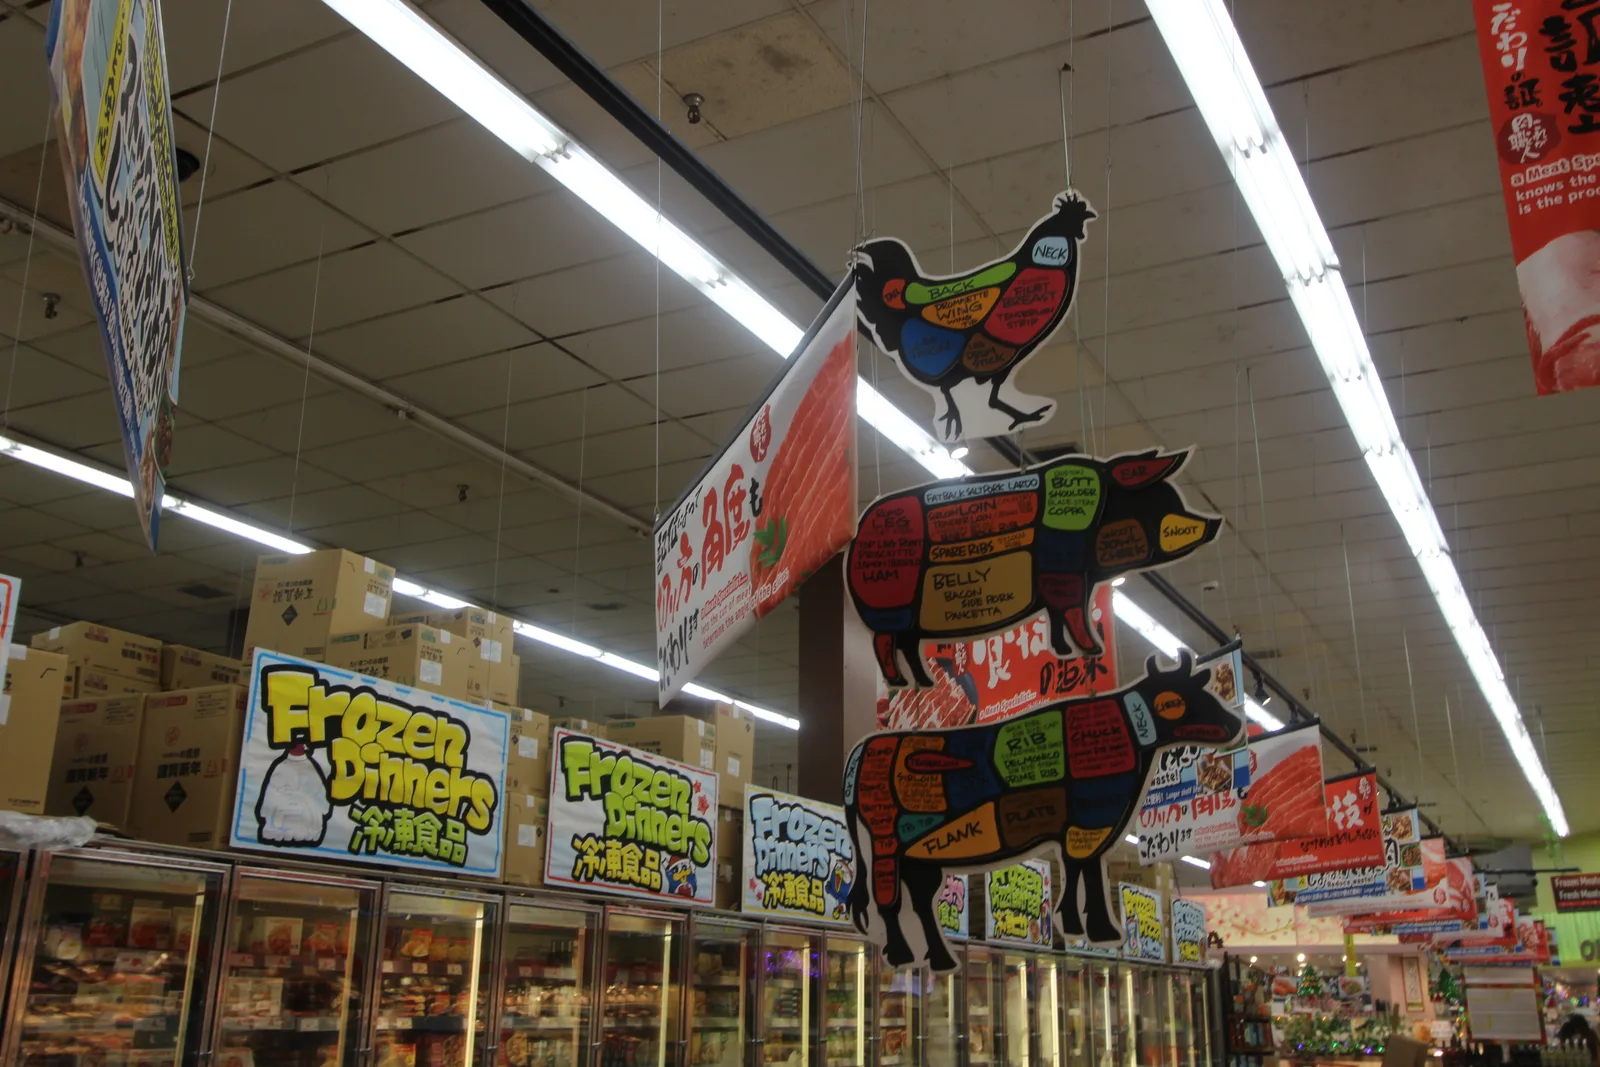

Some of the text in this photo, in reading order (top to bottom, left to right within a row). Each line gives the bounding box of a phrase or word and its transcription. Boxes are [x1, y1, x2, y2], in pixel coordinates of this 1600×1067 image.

[1510, 173, 1525, 189] a
[1526, 157, 1571, 184] Meat
[1516, 173, 1597, 202] knows the
[1518, 200, 1532, 216] is
[1536, 195, 1563, 211] the
[1034, 243, 1068, 261] NECK
[929, 280, 974, 300] BACK
[1003, 291, 1058, 308] BREAST
[936, 302, 983, 321] WING
[1050, 476, 1095, 489] BUTT
[1048, 487, 1097, 499] SHOULDER
[959, 499, 997, 516] LOIN
[872, 516, 911, 530] LEG
[931, 545, 967, 561] SPARE
[967, 540, 995, 556] RIBS
[863, 569, 899, 584] HAM
[932, 566, 991, 590] BELLY
[944, 587, 983, 602] BACON
[961, 592, 1015, 609] SIDE PORK
[944, 607, 1002, 621] PANCETTA
[262, 665, 470, 768] Frozen
[1132, 702, 1149, 738] NECK
[1006, 733, 1047, 753] RIB
[1071, 727, 1122, 743] CHUCK
[561, 737, 692, 816] Frozen
[1040, 767, 1059, 778] RIB
[329, 738, 497, 834] Dinners
[1003, 804, 1057, 826] PLATE
[604, 791, 711, 867] Dinners
[750, 794, 852, 862] Frozen
[922, 820, 984, 856] FLANK
[753, 836, 829, 880] Dinners
